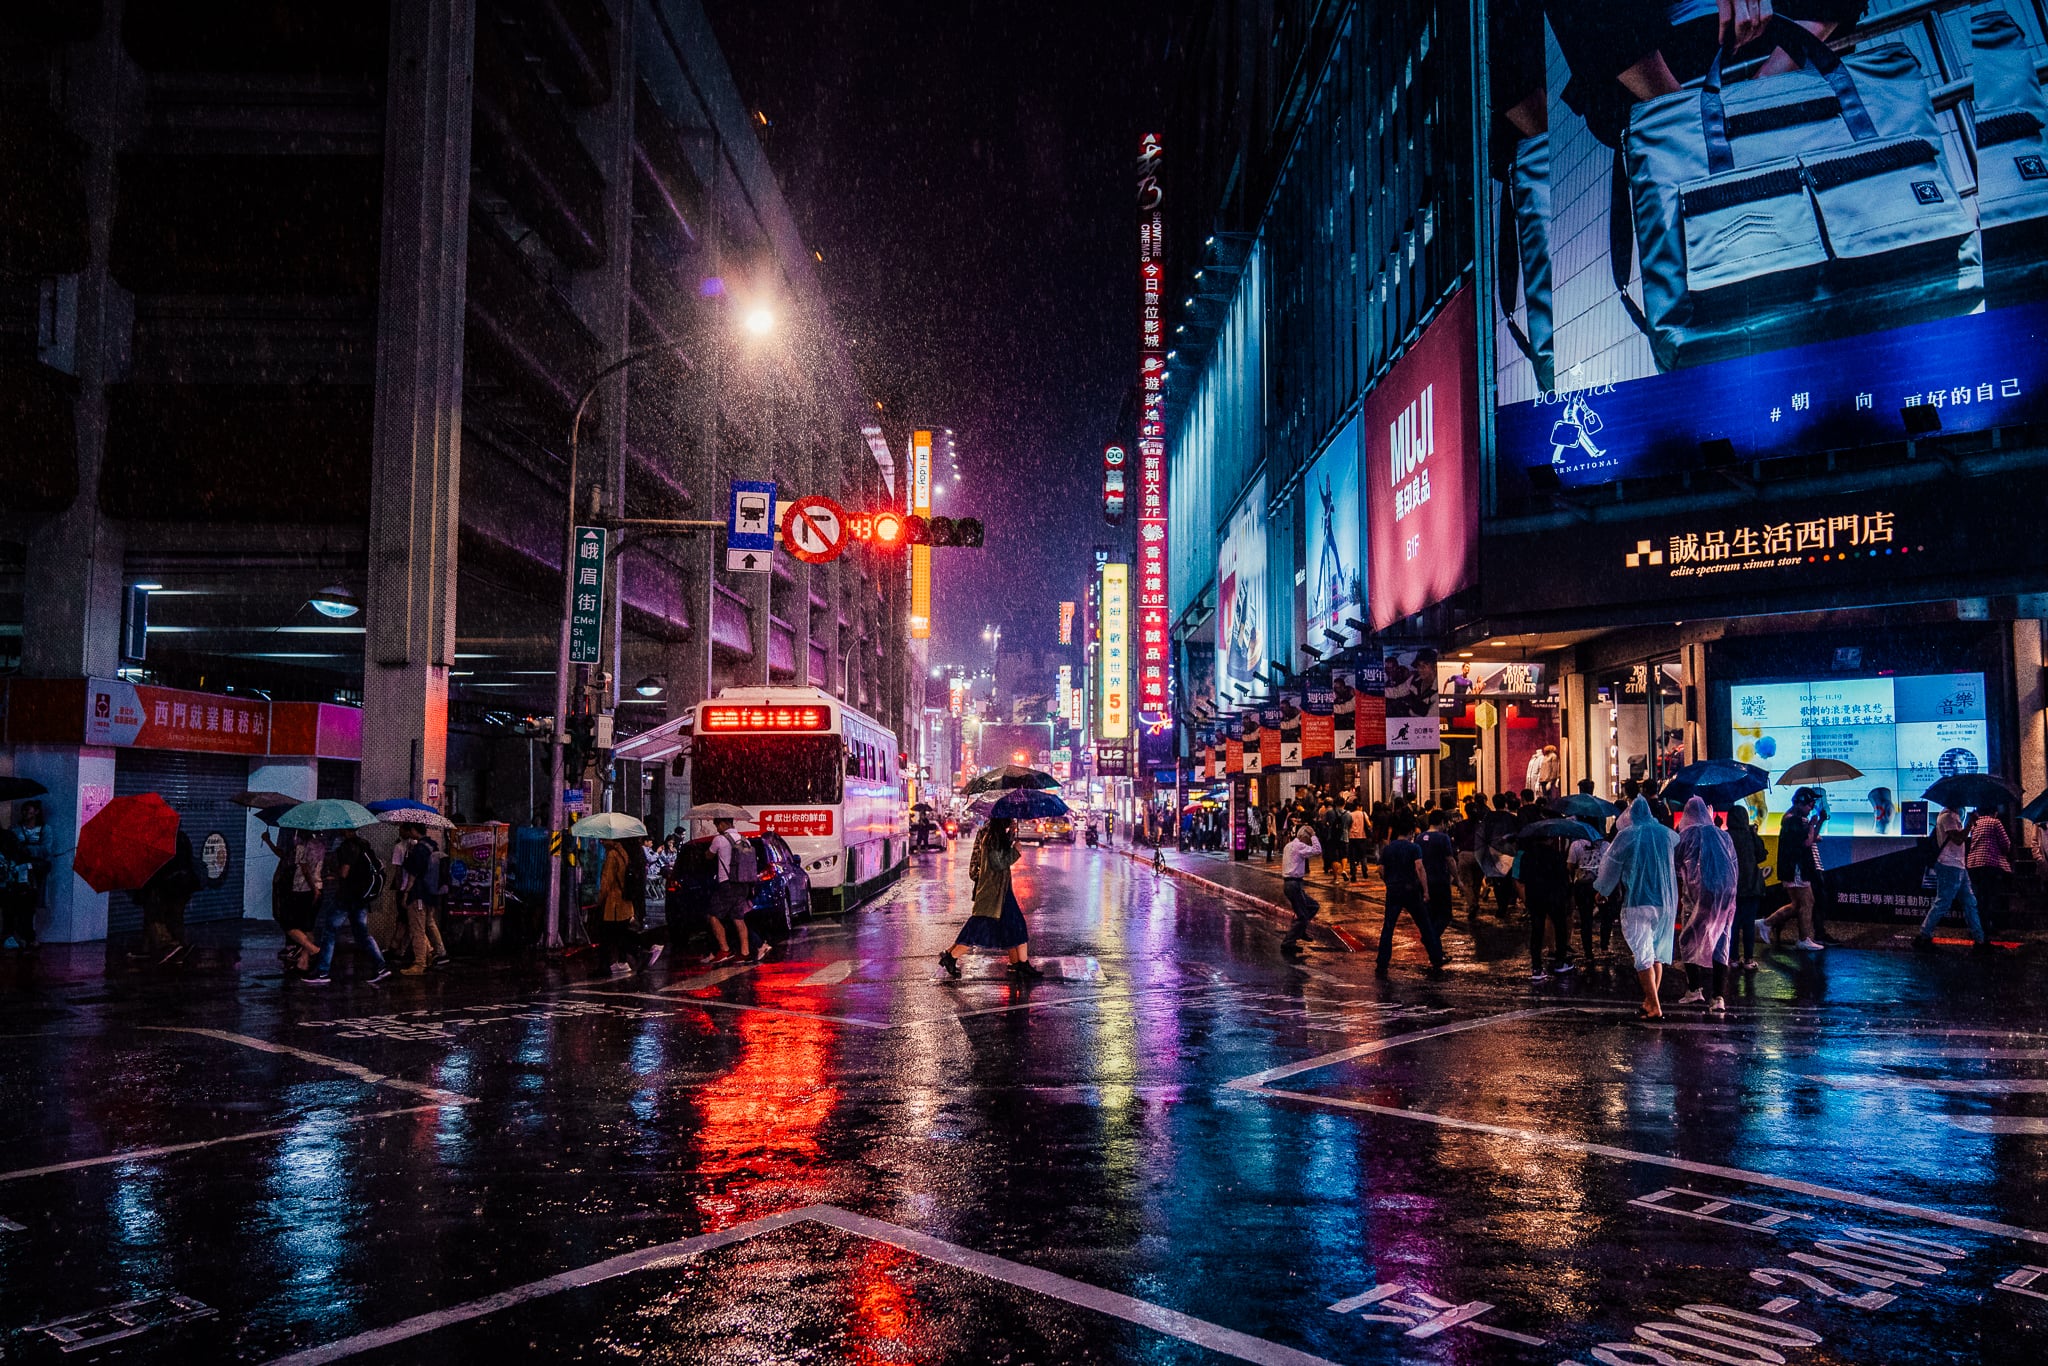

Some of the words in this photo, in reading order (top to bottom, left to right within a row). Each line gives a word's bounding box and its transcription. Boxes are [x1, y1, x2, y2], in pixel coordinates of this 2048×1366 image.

[1141, 224, 1151, 262] CINEMAS
[1152, 211, 1162, 257] SHOWTIME
[1144, 264, 1159, 347] 今日數位影城
[1390, 383, 1434, 487] MUJI
[917, 453, 929, 486] Holiday
[1145, 457, 1160, 507] 新利大雅
[1395, 467, 1431, 523] 無印良品
[1144, 508, 1161, 517] 7F
[850, 519, 872, 539] 43
[1669, 511, 1895, 565] 誠品生活西門店
[1406, 532, 1420, 561] B1F
[578, 541, 599, 612] 峨眉街
[1145, 546, 1160, 591] 香滿樓
[1670, 566, 1694, 577] eslite
[1695, 561, 1740, 577] spectrum
[1742, 558, 1775, 571] ximen
[1777, 556, 1802, 567] store
[1142, 594, 1164, 604] 5.6F
[573, 616, 596, 625] EMei
[573, 628, 584, 636] St.
[586, 647, 596, 655] 52
[1146, 630, 1161, 696] 誠品商場
[1503, 674, 1525, 684] YOUR
[1507, 665, 1530, 675] ROCK
[1508, 682, 1537, 693] LIMITS
[154, 700, 264, 735] 西門就業服務站
[1100, 750, 1124, 760] U2
[774, 813, 827, 823] 獻出你的鮮血
